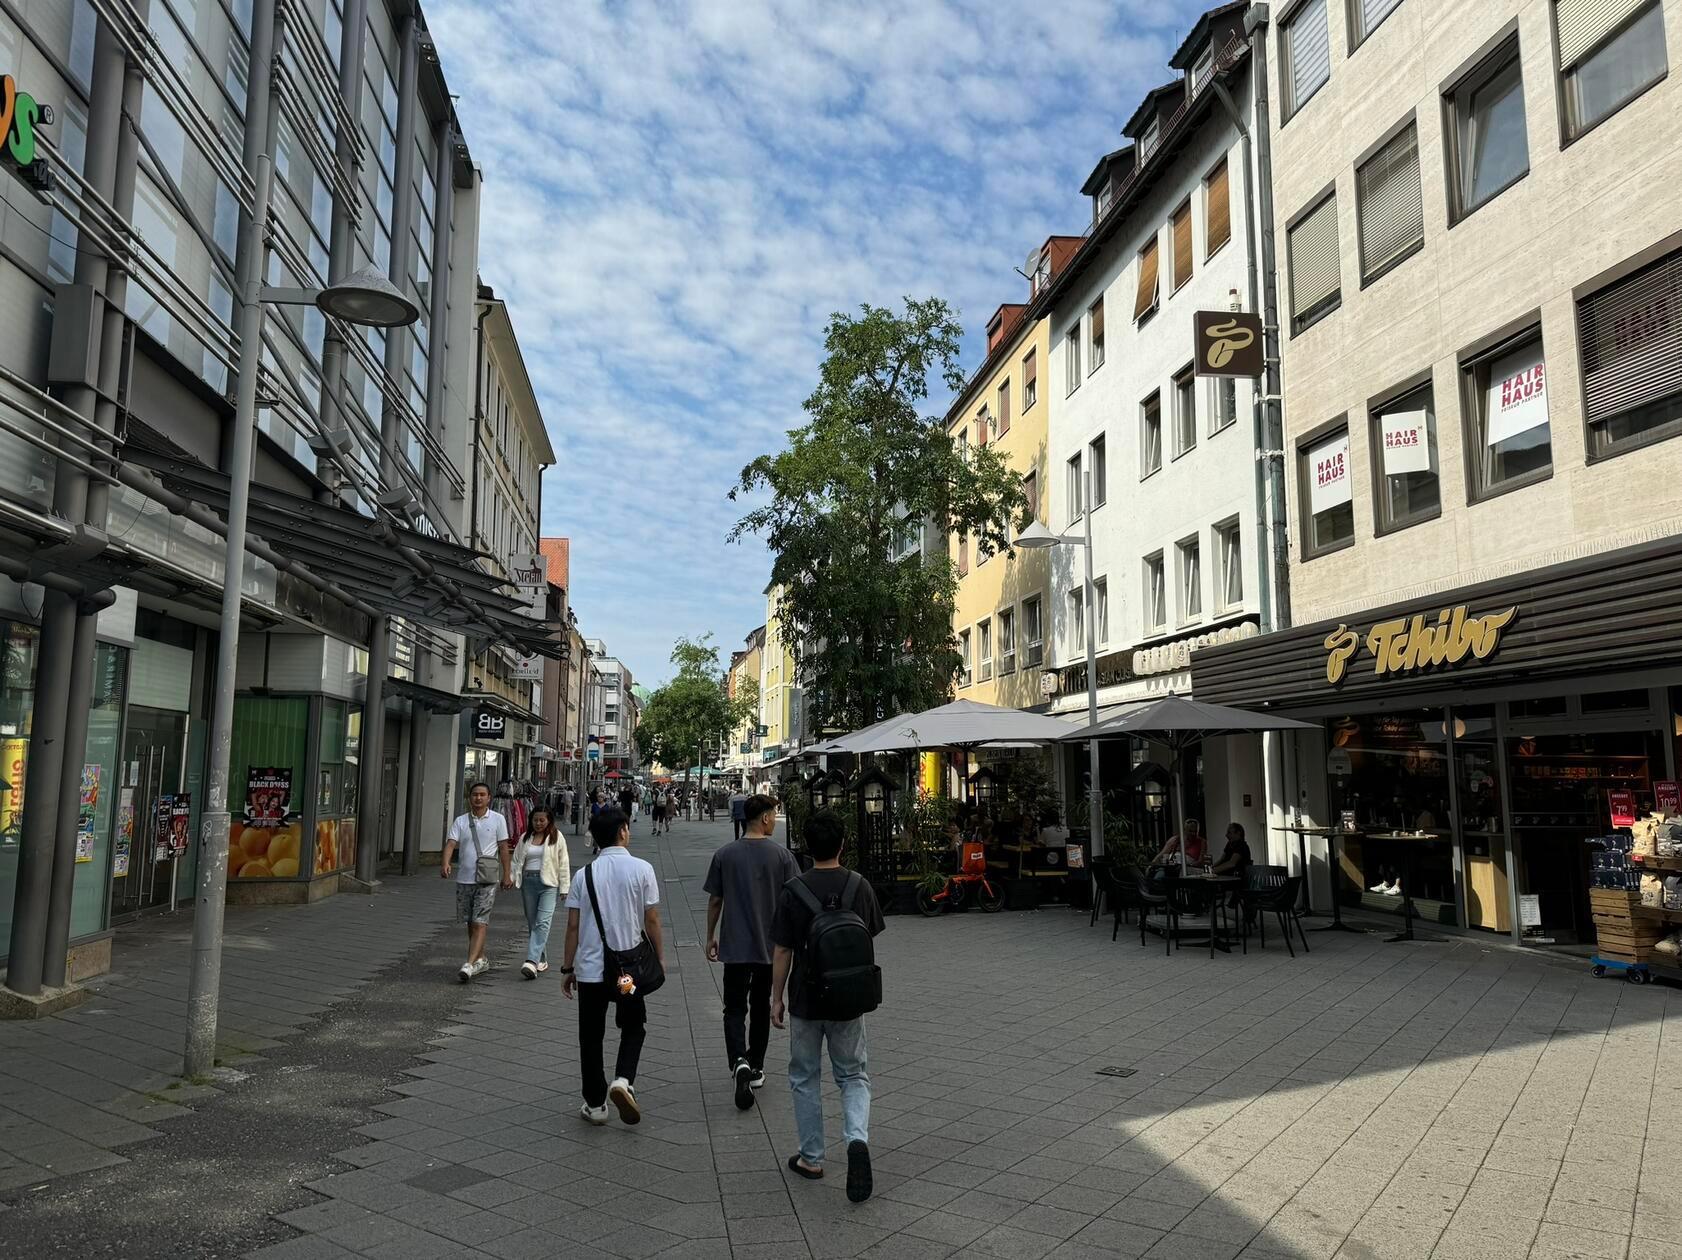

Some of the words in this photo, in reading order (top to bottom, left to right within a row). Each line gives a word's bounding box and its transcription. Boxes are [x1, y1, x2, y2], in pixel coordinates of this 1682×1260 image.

[1502, 363, 1544, 394] HAIR
[1502, 378, 1544, 408] HAUS
[1385, 429, 1418, 440] HAIR
[1386, 436, 1419, 447] HAUS
[1317, 453, 1344, 473] HAIR
[1318, 464, 1345, 485] HAUS
[1366, 605, 1520, 674] Tchibo
